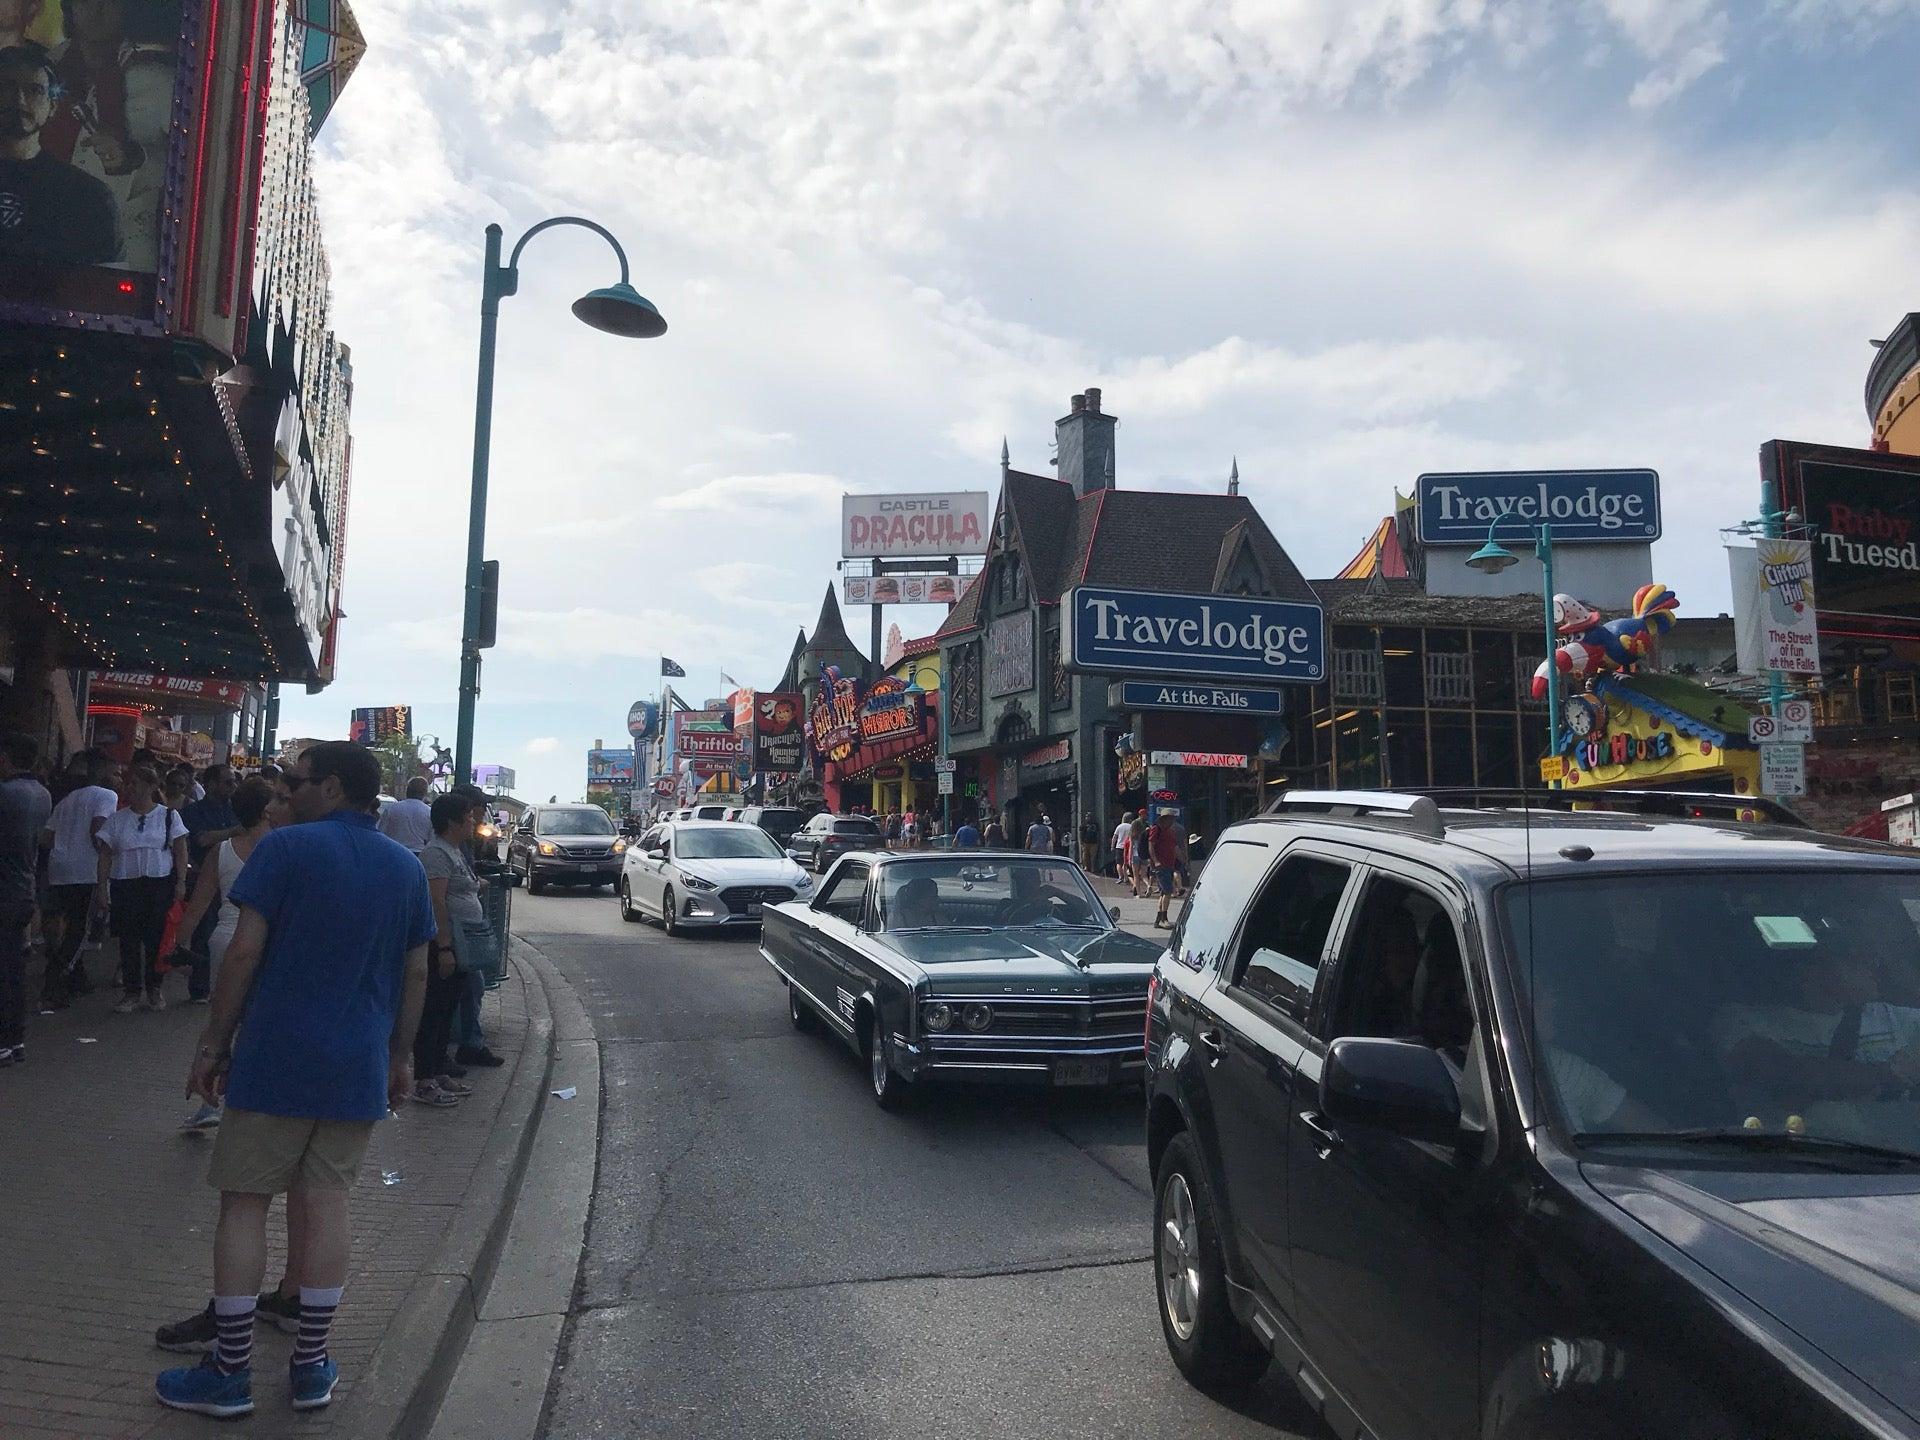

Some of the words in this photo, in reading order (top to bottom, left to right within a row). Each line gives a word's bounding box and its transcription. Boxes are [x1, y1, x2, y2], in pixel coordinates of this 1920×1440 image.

[879, 499, 949, 512] CASTLE
[1430, 483, 1644, 530] Travelodge
[849, 511, 982, 551] DRACULA
[1828, 500, 1912, 546] Ruby
[1763, 562, 1807, 586] Clifton
[1780, 581, 1805, 606] Hill
[1085, 597, 1310, 666] Travelodge
[1768, 630, 1786, 643] The
[1787, 631, 1813, 645] Street
[1780, 643, 1789, 656] of
[1790, 643, 1804, 657] fun
[1769, 658, 1780, 669] at
[1780, 656, 1795, 670] the
[1796, 657, 1816, 671] Falls
[166, 677, 205, 693] RIDES
[1156, 688, 1178, 704] At
[1182, 690, 1208, 706] the
[1210, 691, 1249, 708] Falls
[813, 702, 833, 739] BIG
[833, 693, 858, 727] TOP
[769, 747, 800, 757] Haunted
[772, 755, 796, 764] Castle
[1179, 752, 1247, 768] VACANCY
[658, 780, 674, 793] DQ
[1152, 790, 1178, 801] OPEN
